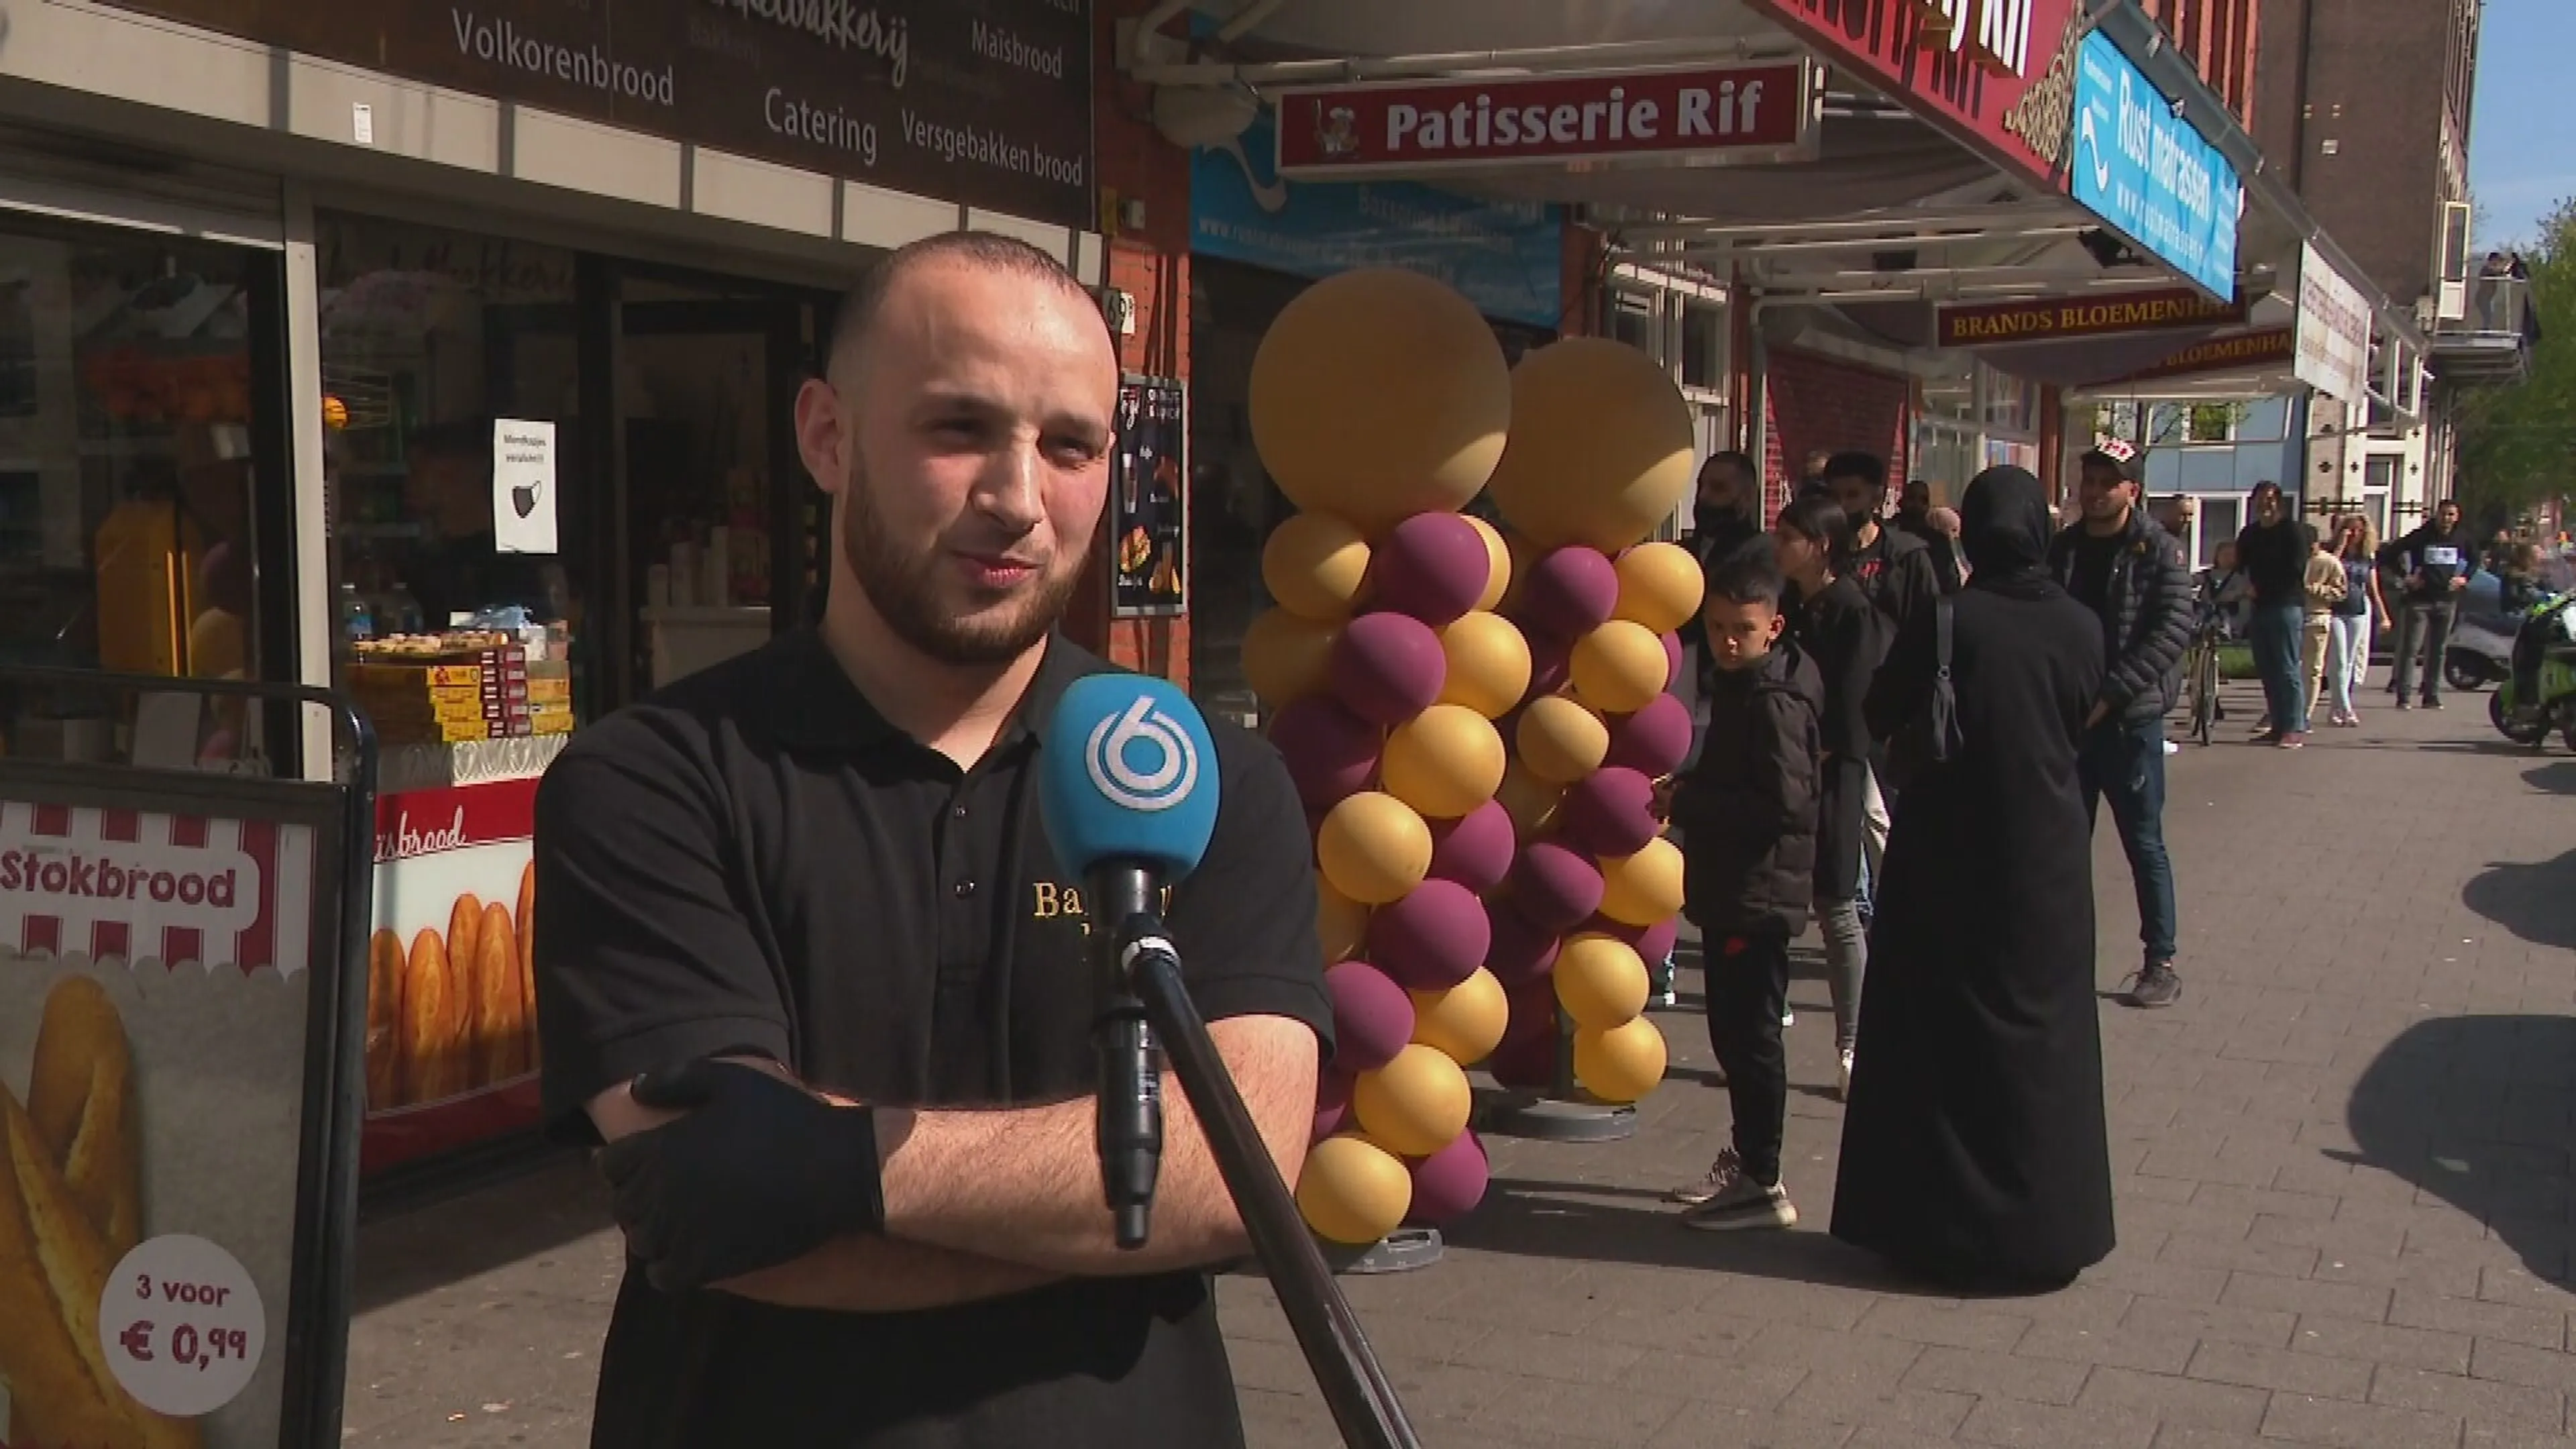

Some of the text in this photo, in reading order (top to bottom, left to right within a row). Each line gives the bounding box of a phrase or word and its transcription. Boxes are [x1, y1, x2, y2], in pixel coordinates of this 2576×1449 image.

[451, 7, 674, 106] Volkorenbrood
[764, 86, 877, 167] Catering
[902, 107, 1083, 187] Versgebakken brood
[1386, 80, 1763, 152] Patisserie Rif
[2117, 67, 2212, 223] Rust matrassen
[1953, 309, 2053, 337] BRANDS
[136, 1275, 231, 1307] 3 voor
[120, 1320, 247, 1372] € 0,99
